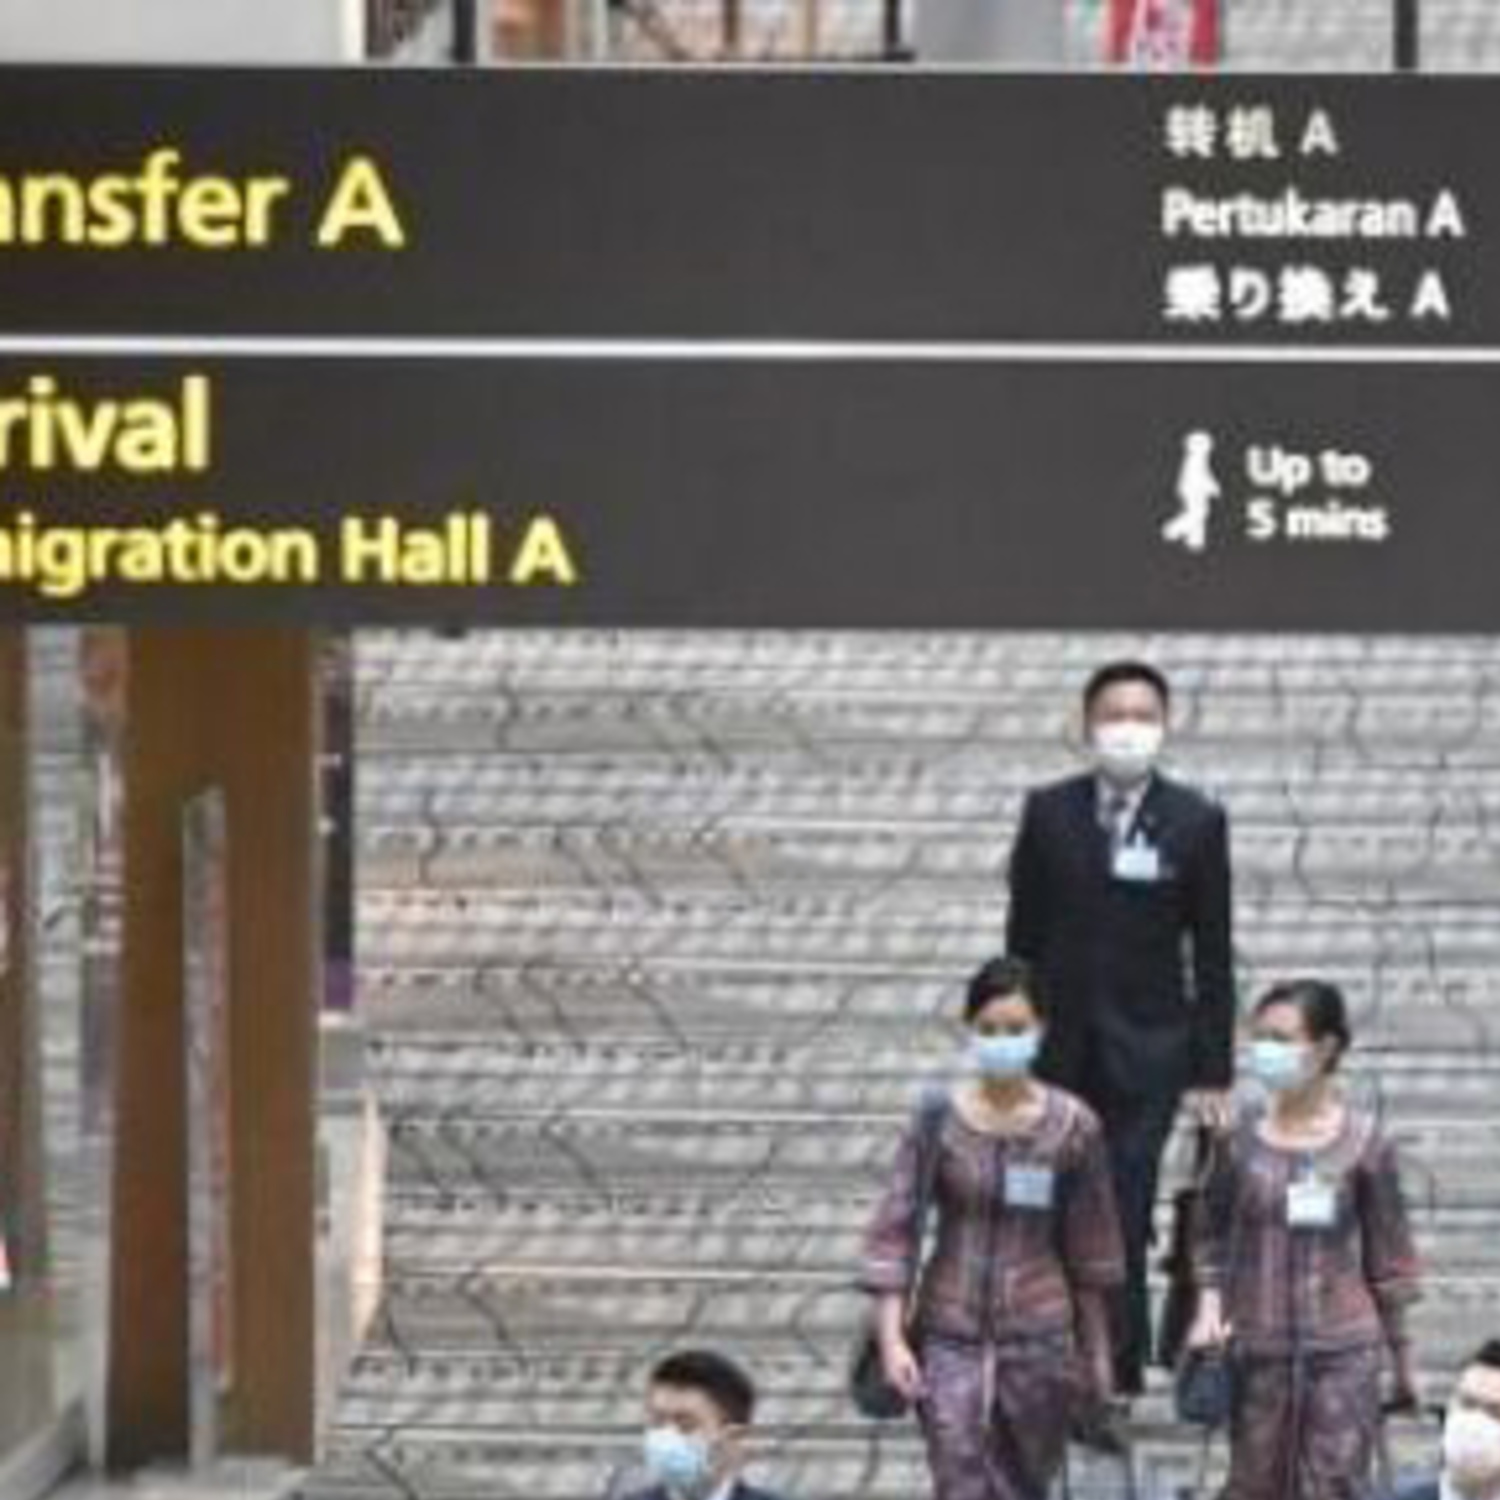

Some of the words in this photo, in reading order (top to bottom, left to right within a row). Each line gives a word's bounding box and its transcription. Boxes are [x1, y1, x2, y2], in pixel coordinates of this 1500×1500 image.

[1165, 105, 1279, 158] 转机
[1300, 110, 1338, 155] A
[0, 149, 288, 246] nsfer
[317, 158, 405, 246] A
[1161, 187, 1417, 238] Pertukaran
[1425, 190, 1465, 238] A
[1163, 264, 1390, 322] 乗り換え
[1410, 270, 1451, 319] A
[0, 375, 209, 471] rival
[1246, 446, 1312, 494] Up
[1319, 448, 1373, 488] to
[1285, 499, 1389, 541] mins
[341, 513, 490, 585] Hall
[510, 516, 576, 585] A
